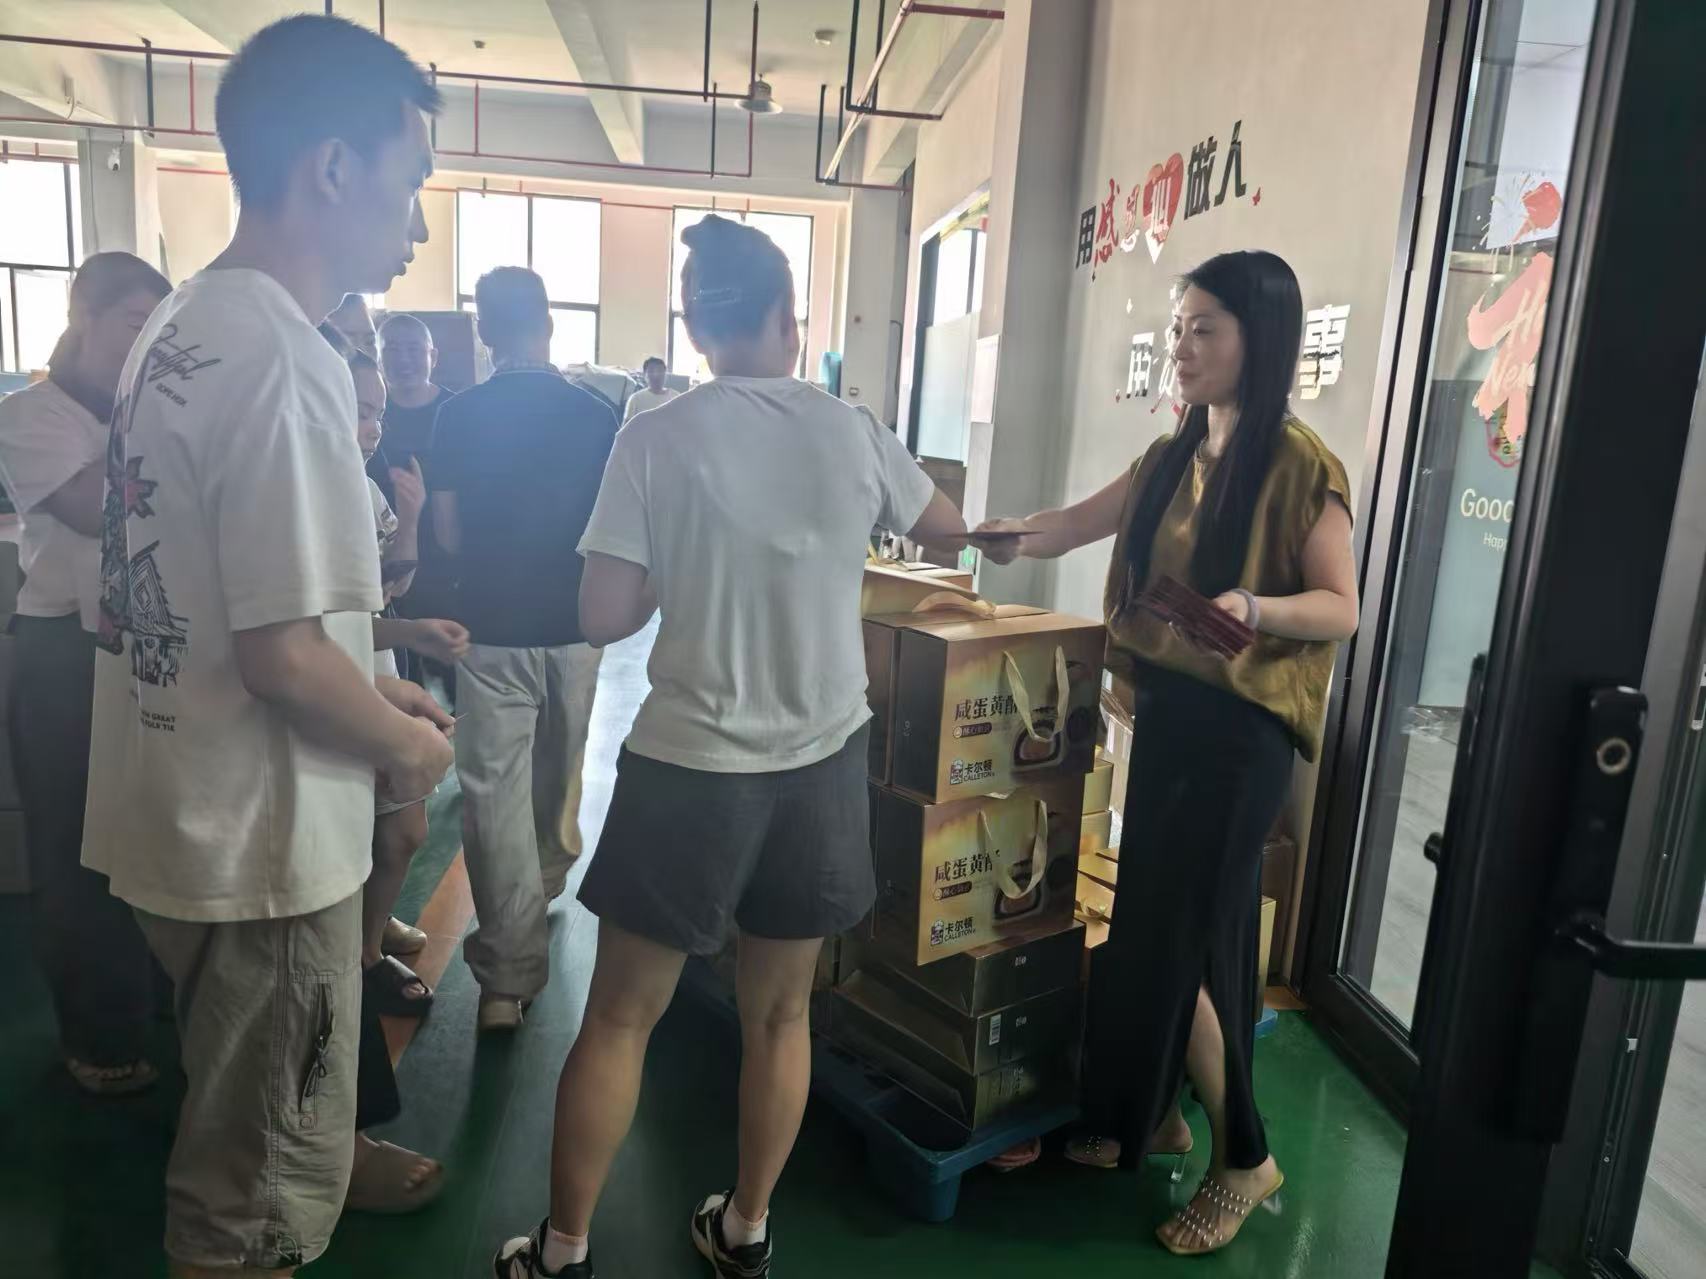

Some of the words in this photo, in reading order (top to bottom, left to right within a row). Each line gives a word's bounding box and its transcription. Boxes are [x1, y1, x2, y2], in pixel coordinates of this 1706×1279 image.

[964, 759, 992, 775] 卡尔顿
[945, 916, 974, 935] 卡尔顿
